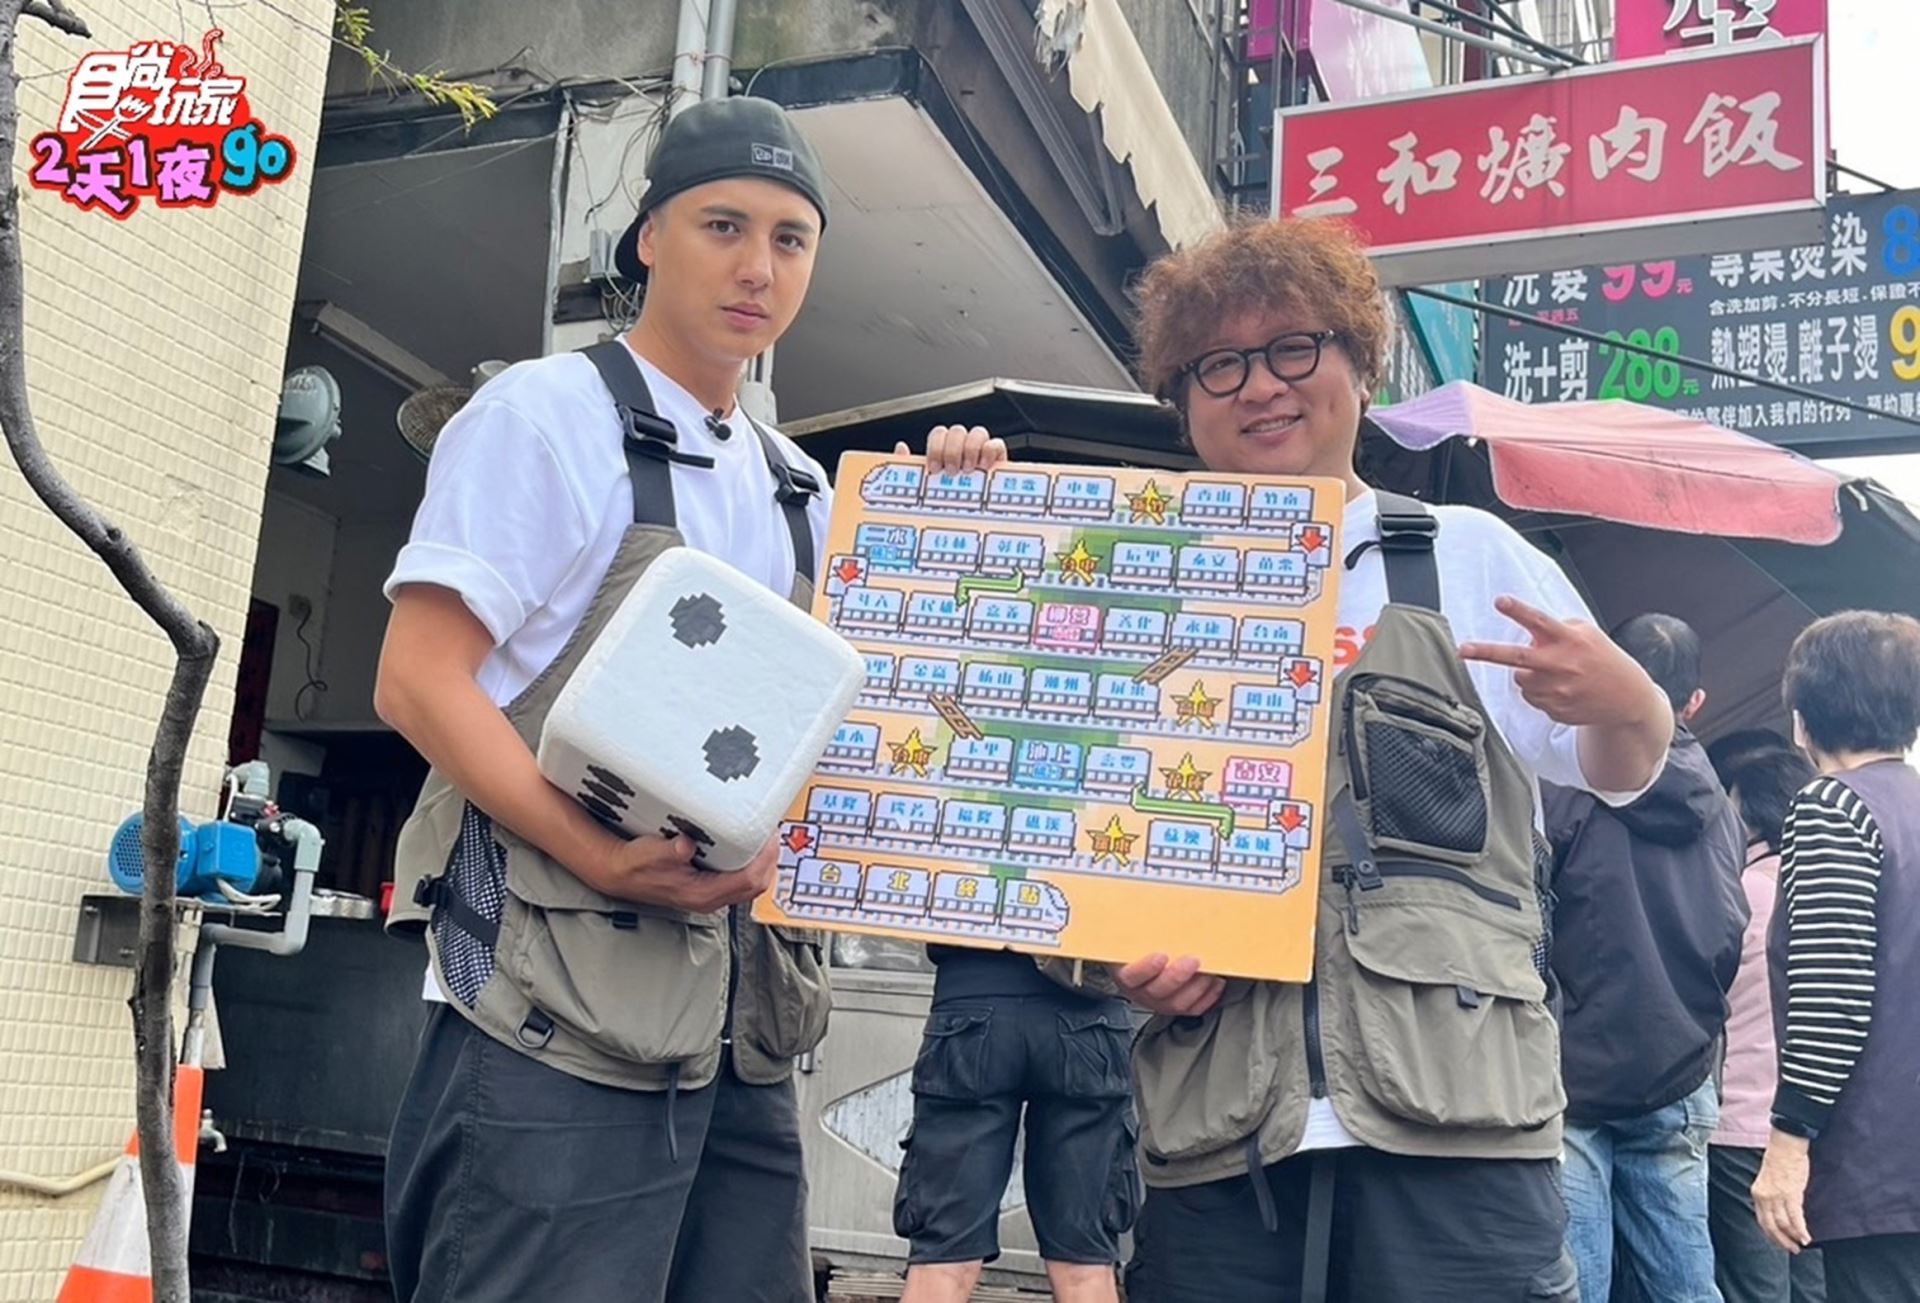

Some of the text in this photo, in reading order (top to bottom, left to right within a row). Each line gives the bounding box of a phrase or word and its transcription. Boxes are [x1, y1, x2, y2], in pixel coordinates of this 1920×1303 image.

[1292, 91, 1803, 217] 三和爌肉飯
[1599, 326, 1700, 402] 288元
